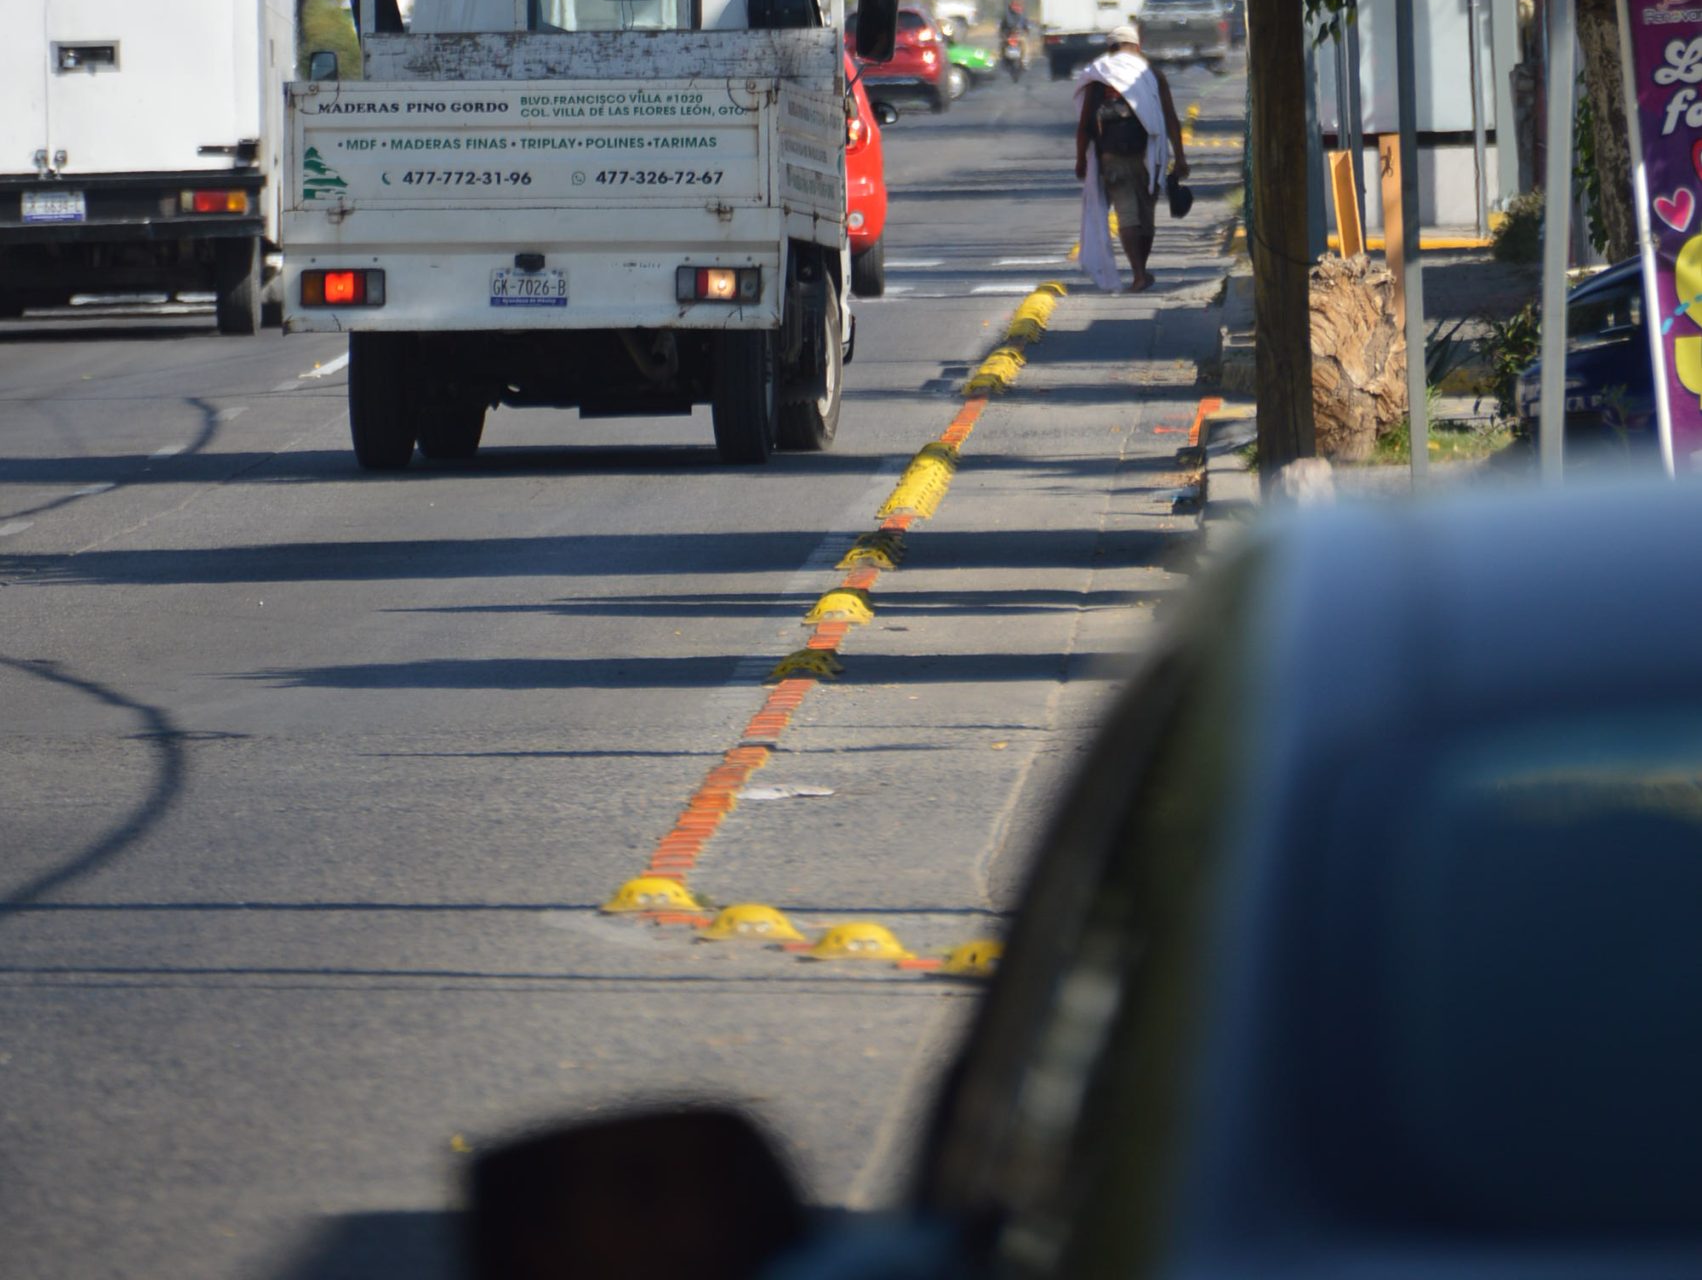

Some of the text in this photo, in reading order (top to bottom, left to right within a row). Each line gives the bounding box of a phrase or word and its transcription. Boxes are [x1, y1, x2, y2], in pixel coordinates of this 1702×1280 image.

[629, 93, 662, 104] VILLA
[318, 102, 508, 114] MADERAS PINO GORDO
[553, 107, 585, 117] VILLA
[590, 107, 604, 116] DE
[609, 106, 630, 116] LAS
[634, 105, 677, 116] FLORES
[347, 136, 717, 150] MDF MADERAS FINAS TRIPLAY POLINES TARIMAS
[403, 171, 532, 186] 477-772-31-96
[596, 171, 724, 185] 477-326-72-67
